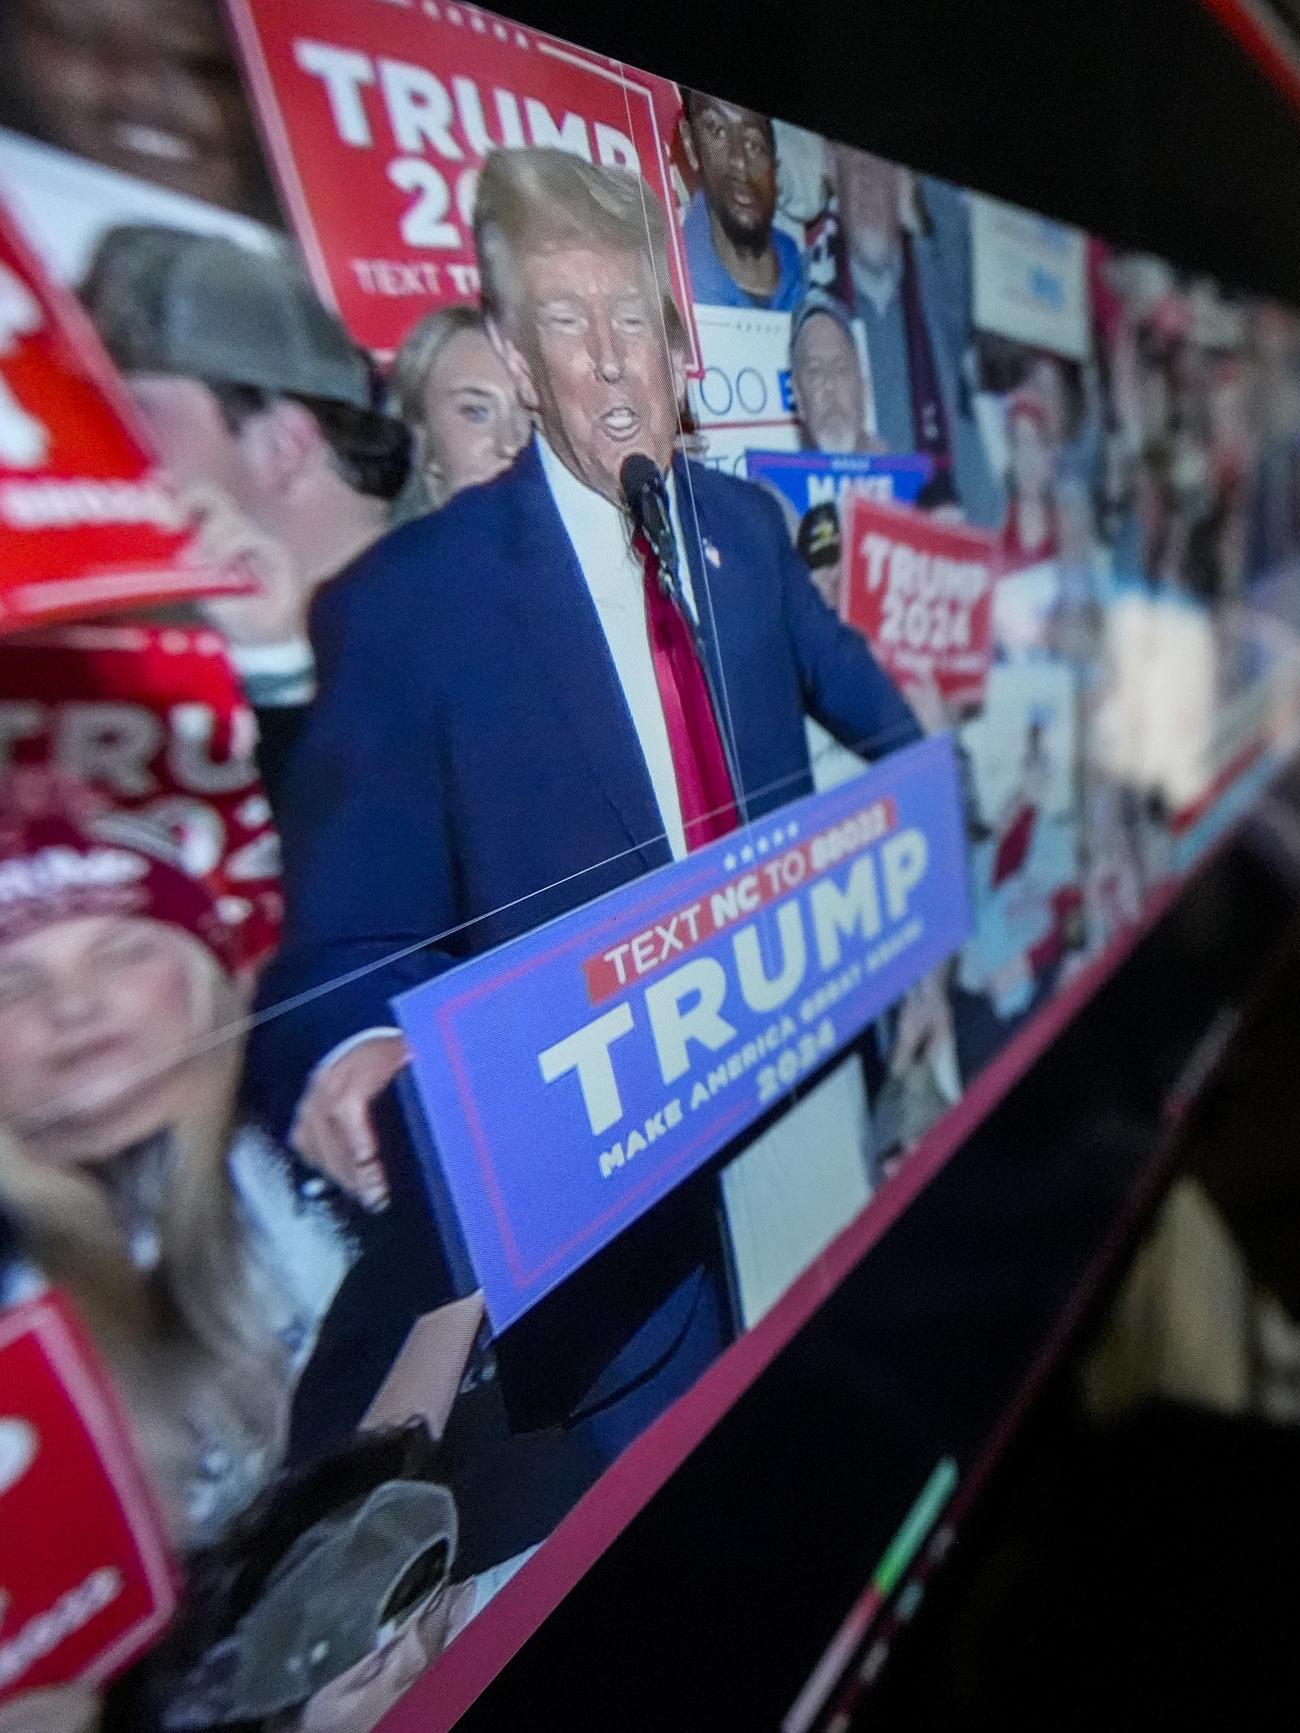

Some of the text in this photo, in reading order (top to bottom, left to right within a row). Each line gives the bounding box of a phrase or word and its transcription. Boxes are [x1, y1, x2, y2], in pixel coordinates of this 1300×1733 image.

[294, 37, 640, 175] TRUMP
[860, 532, 990, 606] TRUMP
[878, 596, 978, 650] 2024
[538, 826, 928, 1137] TRUMP
[603, 903, 703, 985] TEXT
[709, 873, 761, 929] NC
[764, 849, 806, 895] TO
[599, 1098, 683, 1178] MAKE
[690, 1014, 797, 1111] AMERICA
[756, 1019, 836, 1103] 2024
